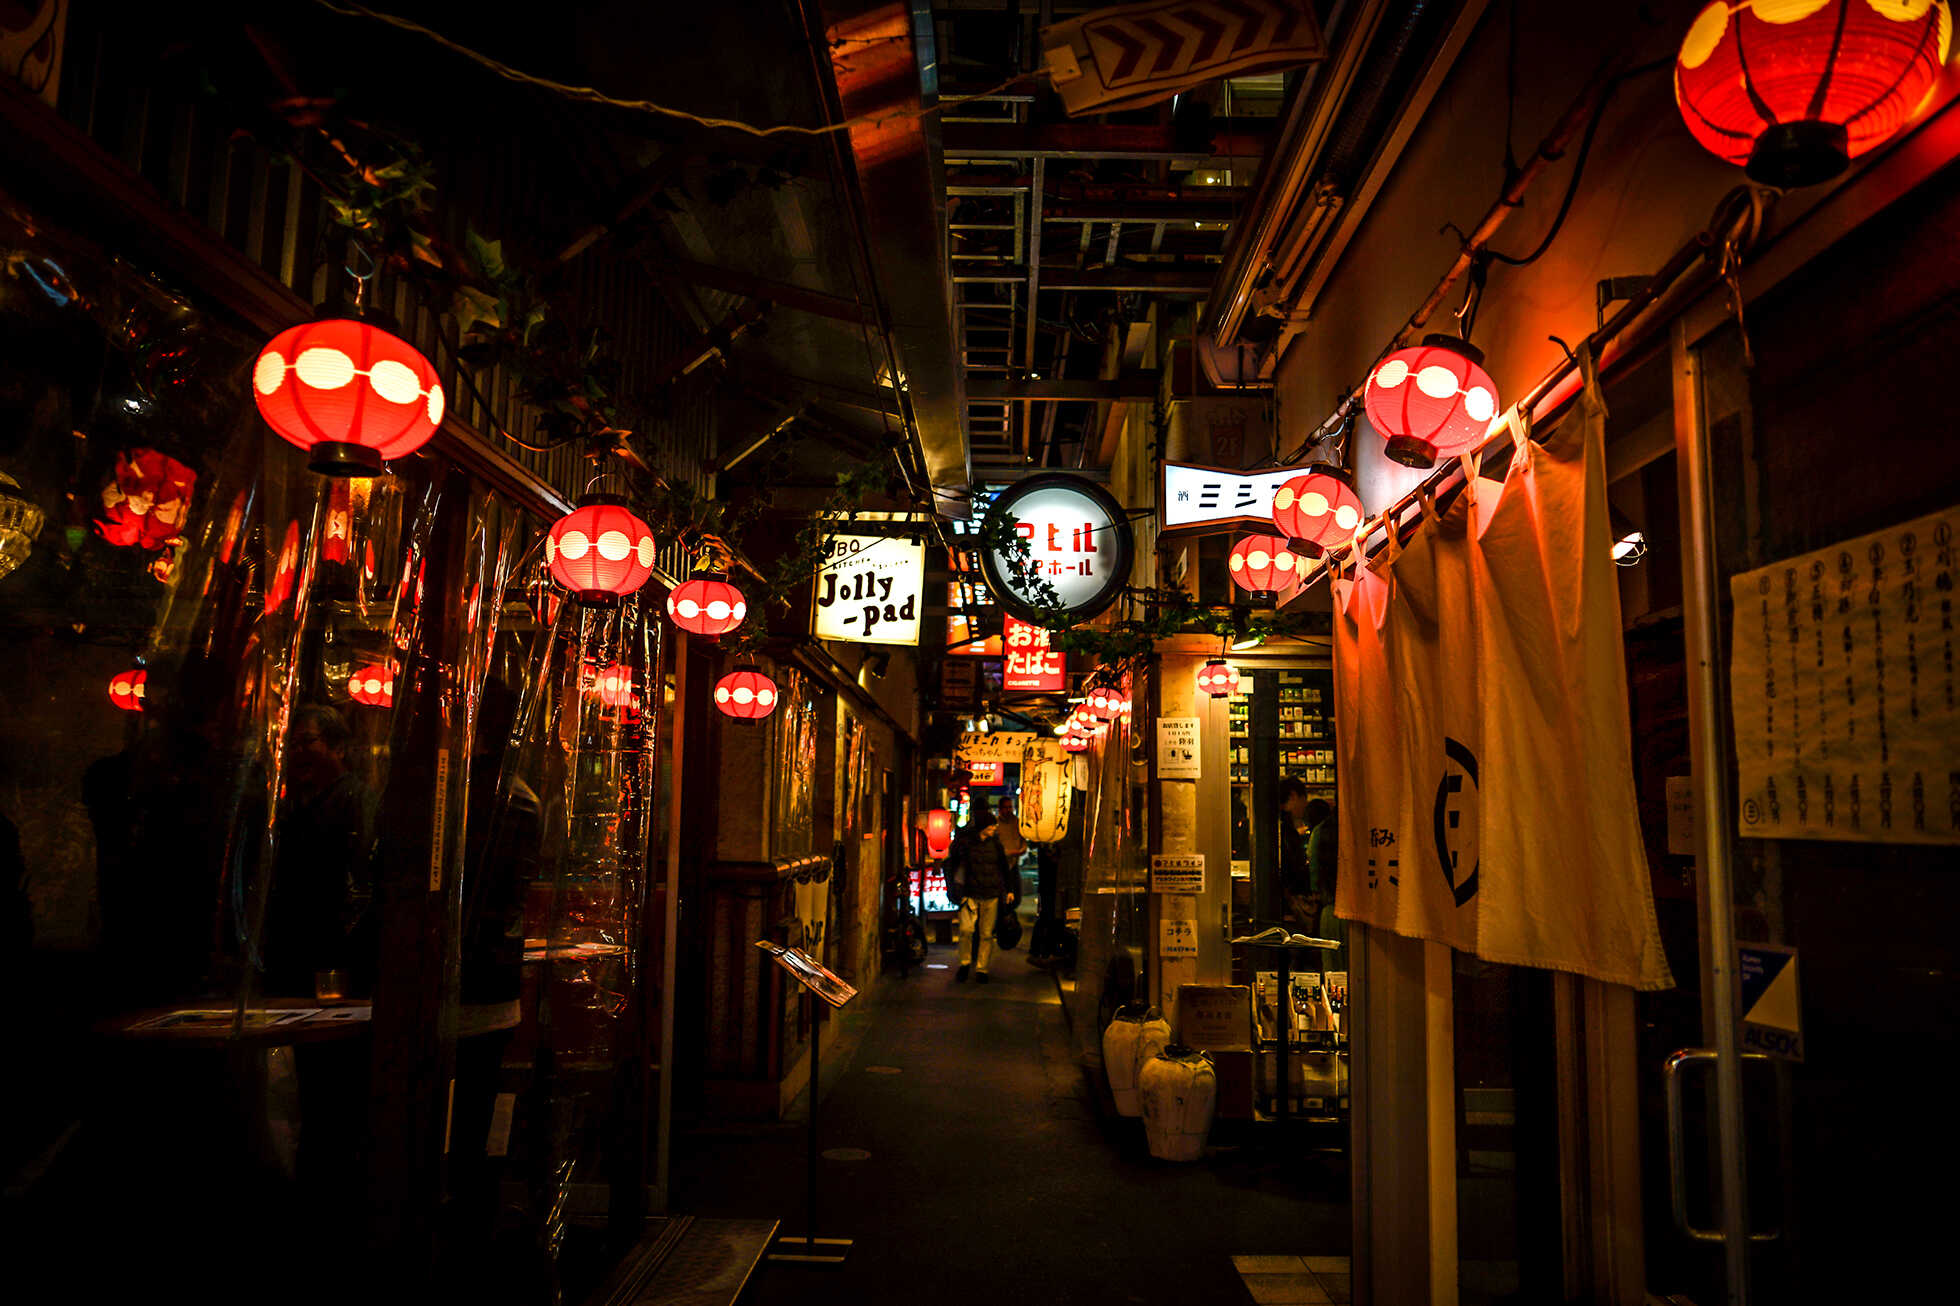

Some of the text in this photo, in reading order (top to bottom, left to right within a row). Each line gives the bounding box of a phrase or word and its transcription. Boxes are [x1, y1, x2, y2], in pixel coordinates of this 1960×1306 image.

[826, 538, 860, 559] BQ
[817, 570, 894, 608] Jolly
[1006, 650, 1060, 675] たばこ
[1745, 1027, 1803, 1058] ALSOK
